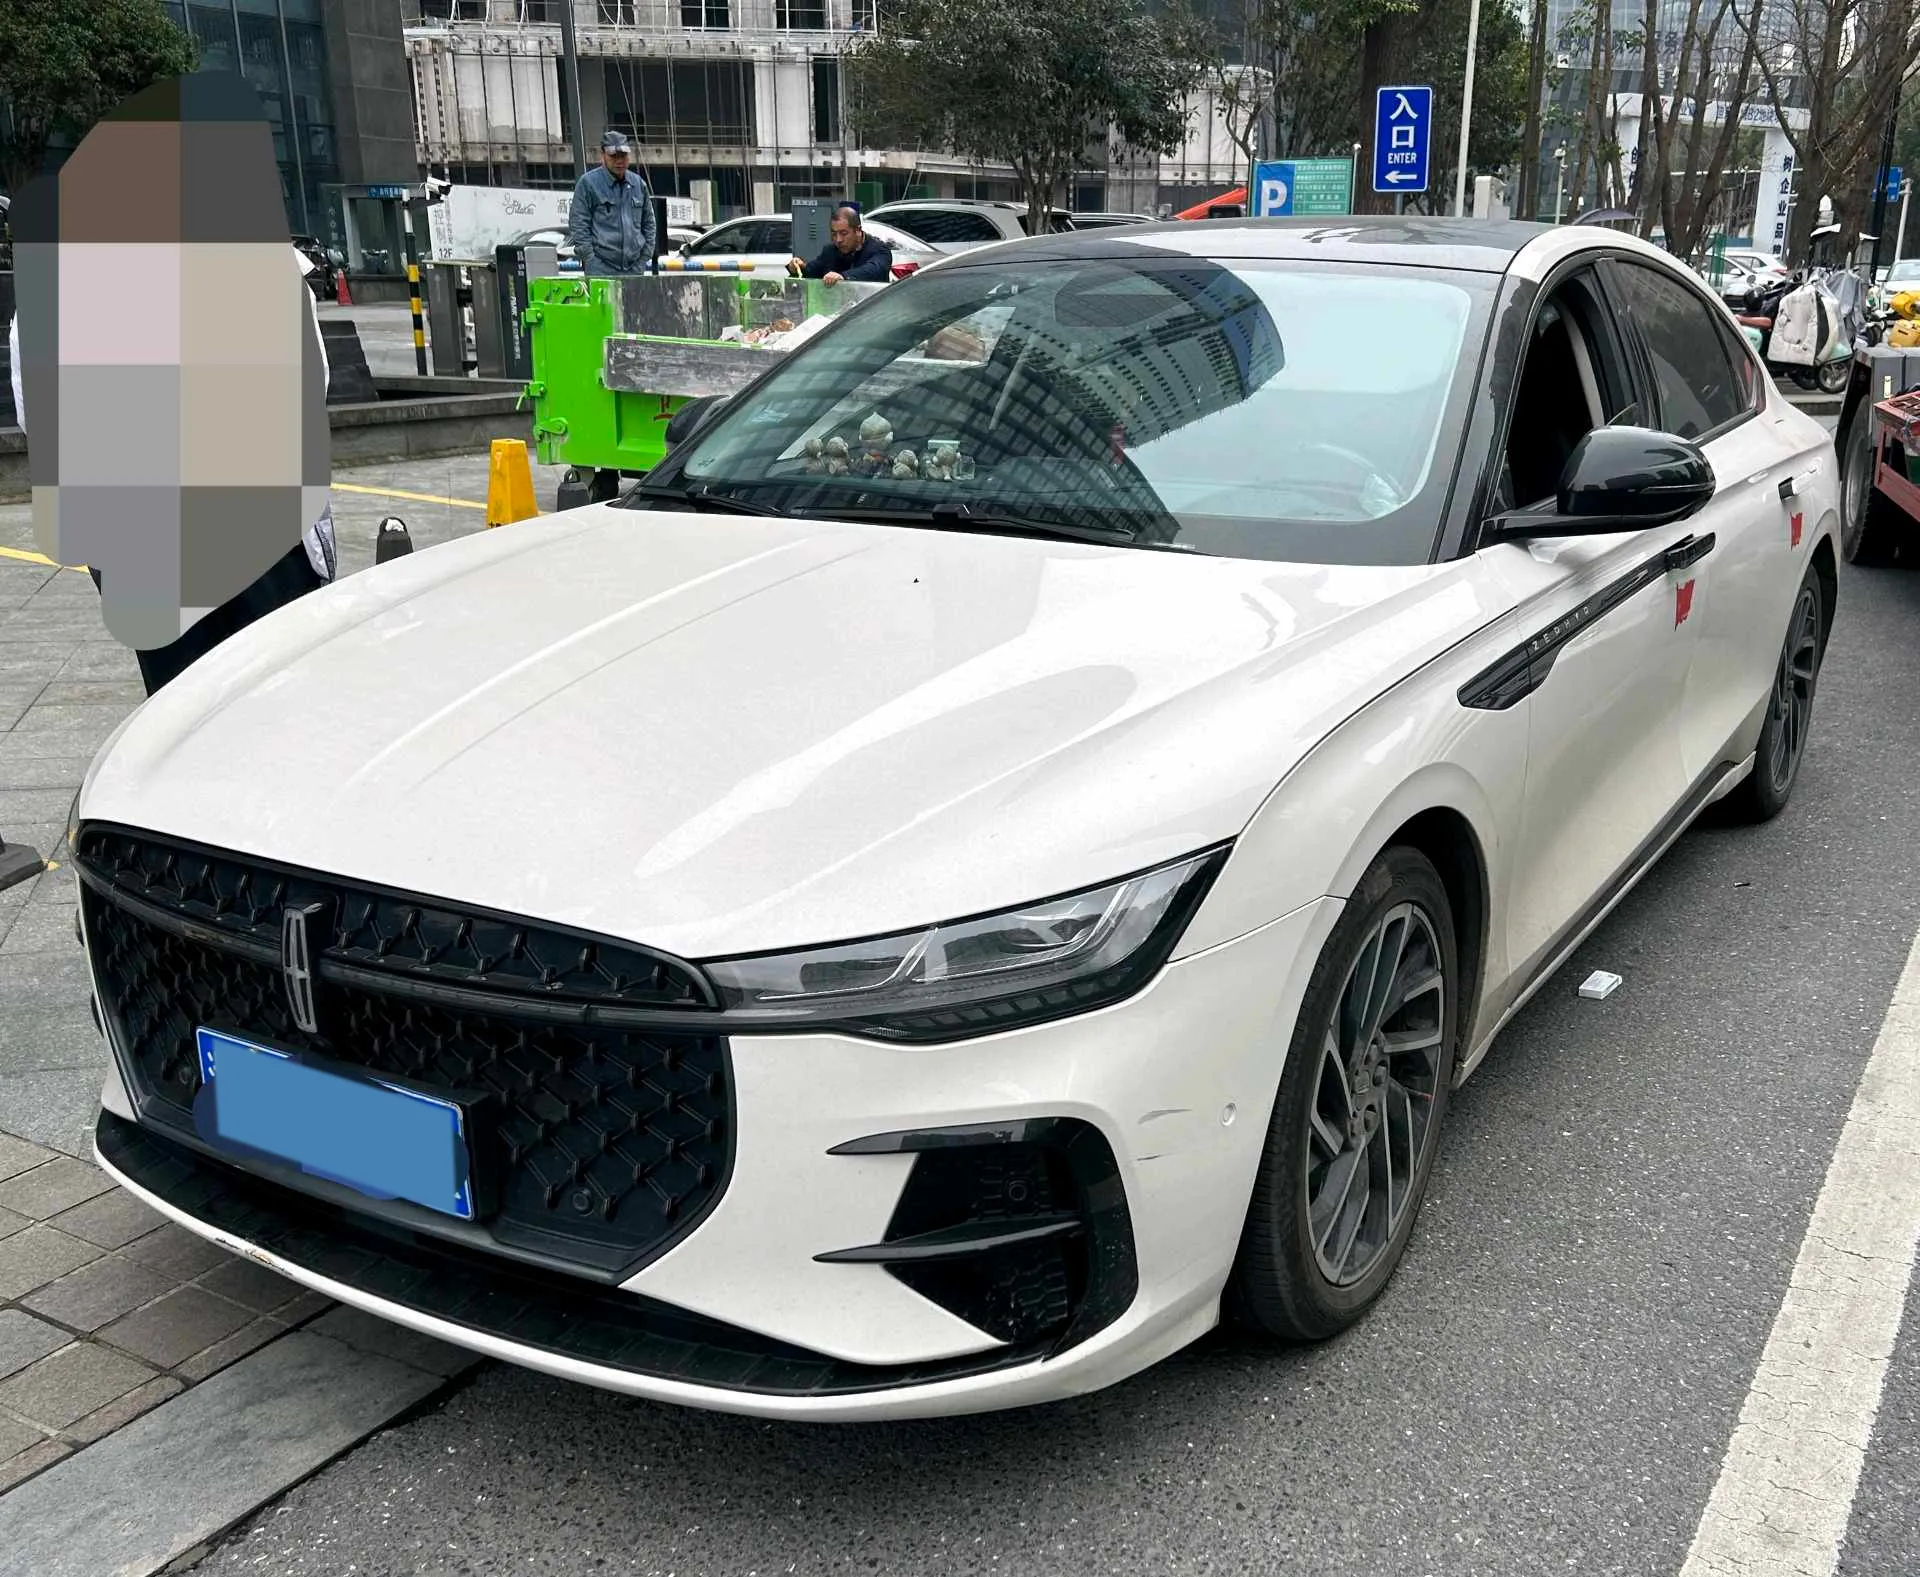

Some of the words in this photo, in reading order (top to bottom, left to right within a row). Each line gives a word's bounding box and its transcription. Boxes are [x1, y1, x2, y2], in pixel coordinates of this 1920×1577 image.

[1389, 93, 1418, 148] 入口
[1388, 152, 1417, 164] ENTER
[1262, 181, 1287, 216] P
